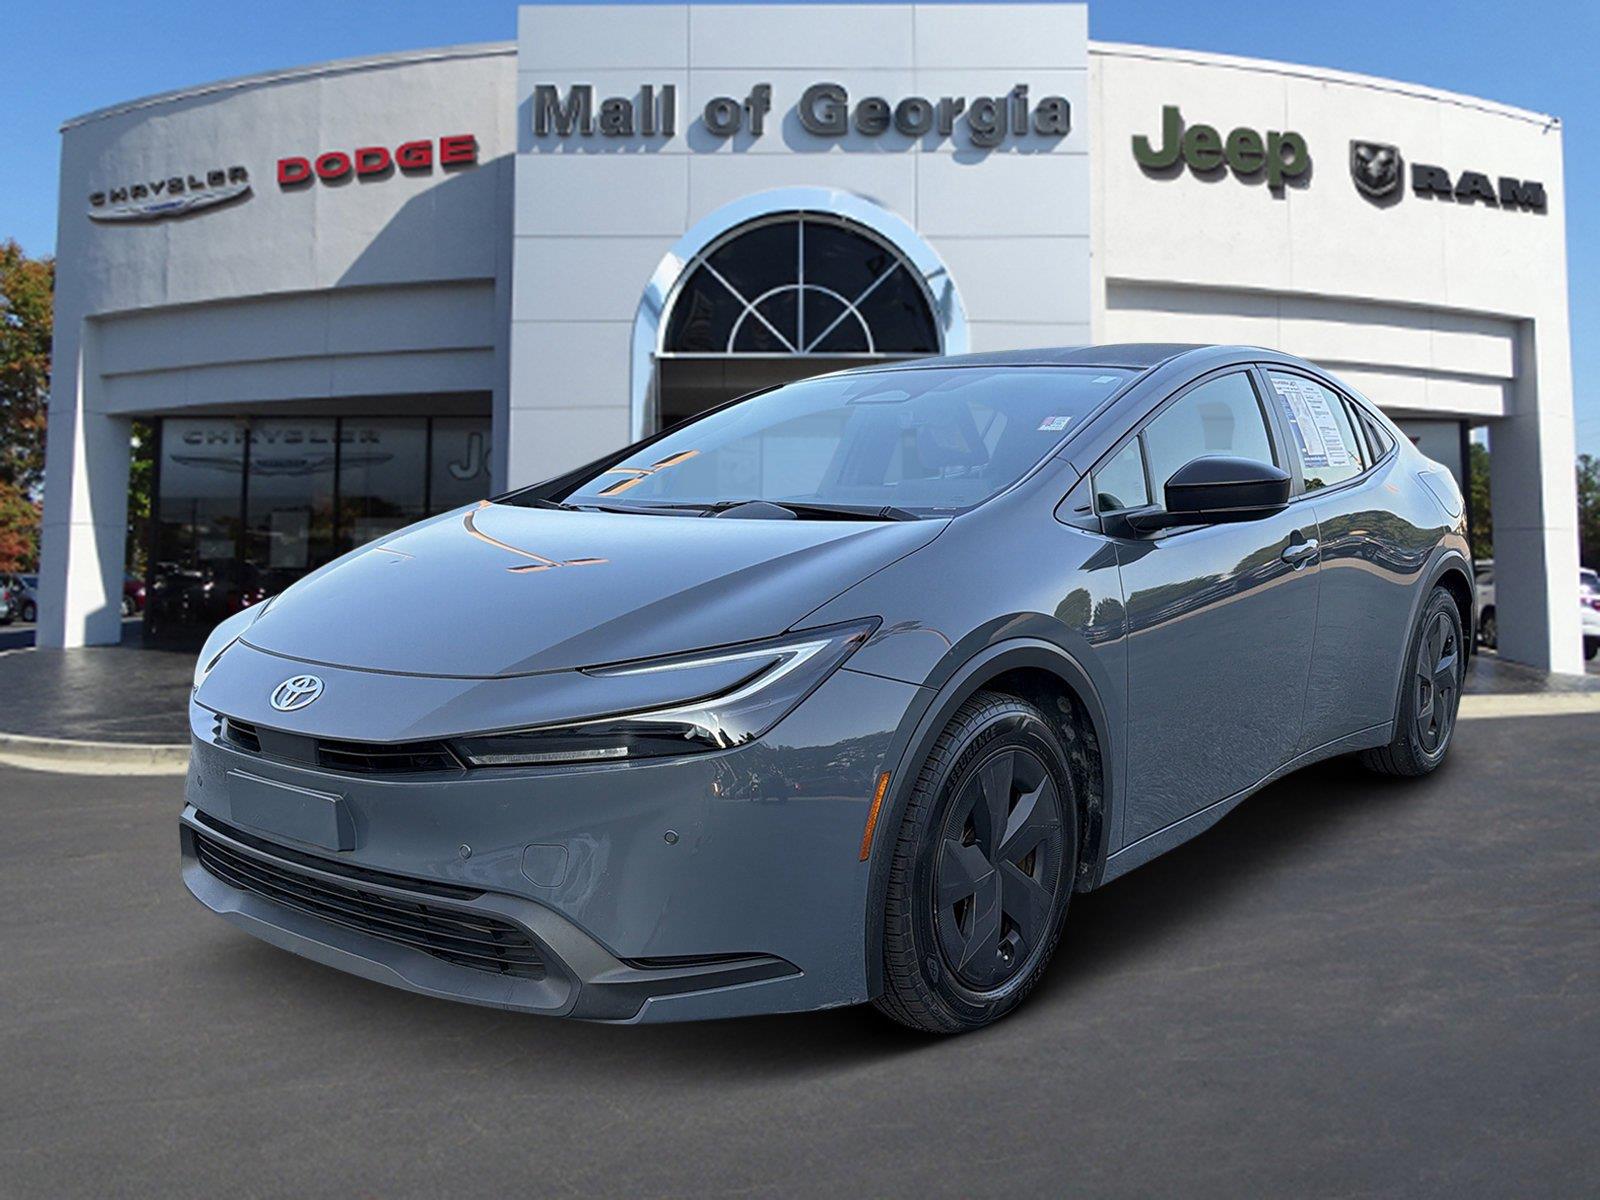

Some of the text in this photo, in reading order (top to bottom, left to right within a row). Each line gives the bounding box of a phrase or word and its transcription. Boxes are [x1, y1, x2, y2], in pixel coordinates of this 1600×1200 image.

[533, 83, 1072, 148] Mall of Georgia
[277, 135, 478, 186] DODGE
[1132, 105, 1309, 192] Jeep
[89, 166, 249, 207] CHRYSLER
[1411, 163, 1547, 212] RAM
